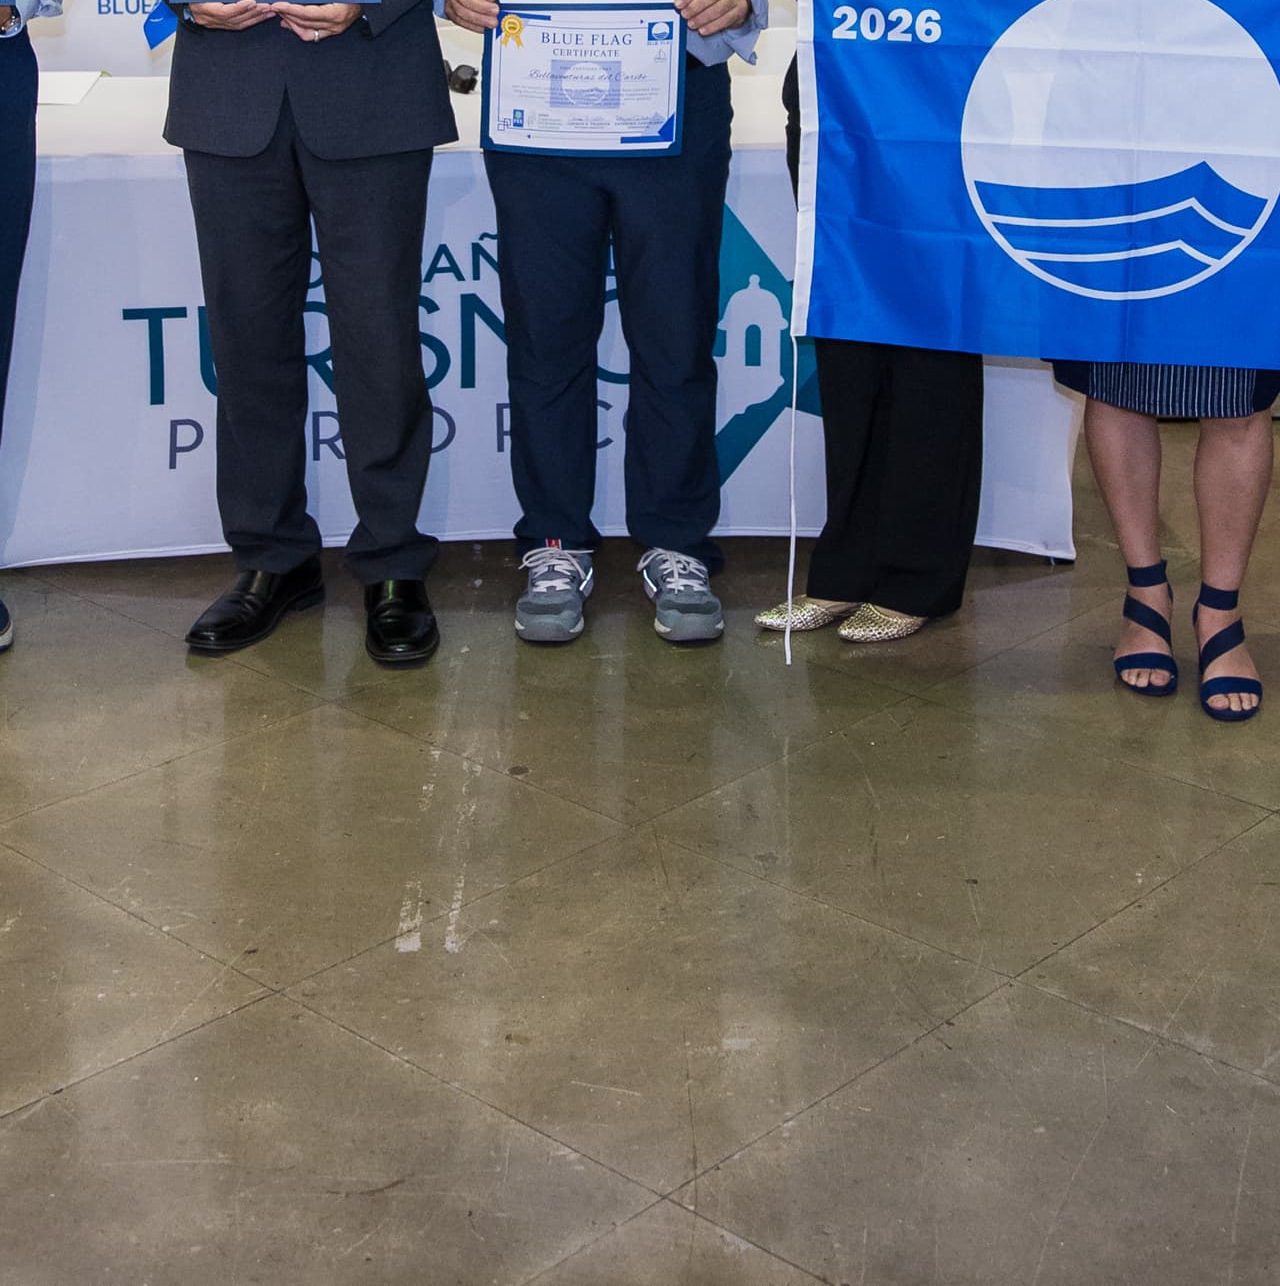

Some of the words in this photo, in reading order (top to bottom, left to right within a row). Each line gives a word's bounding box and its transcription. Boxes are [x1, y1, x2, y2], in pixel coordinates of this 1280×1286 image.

[831, 6, 942, 44] 2026
[541, 32, 584, 45] BLUE
[591, 33, 633, 46] FLAG
[552, 49, 620, 57] CERTIFICATE
